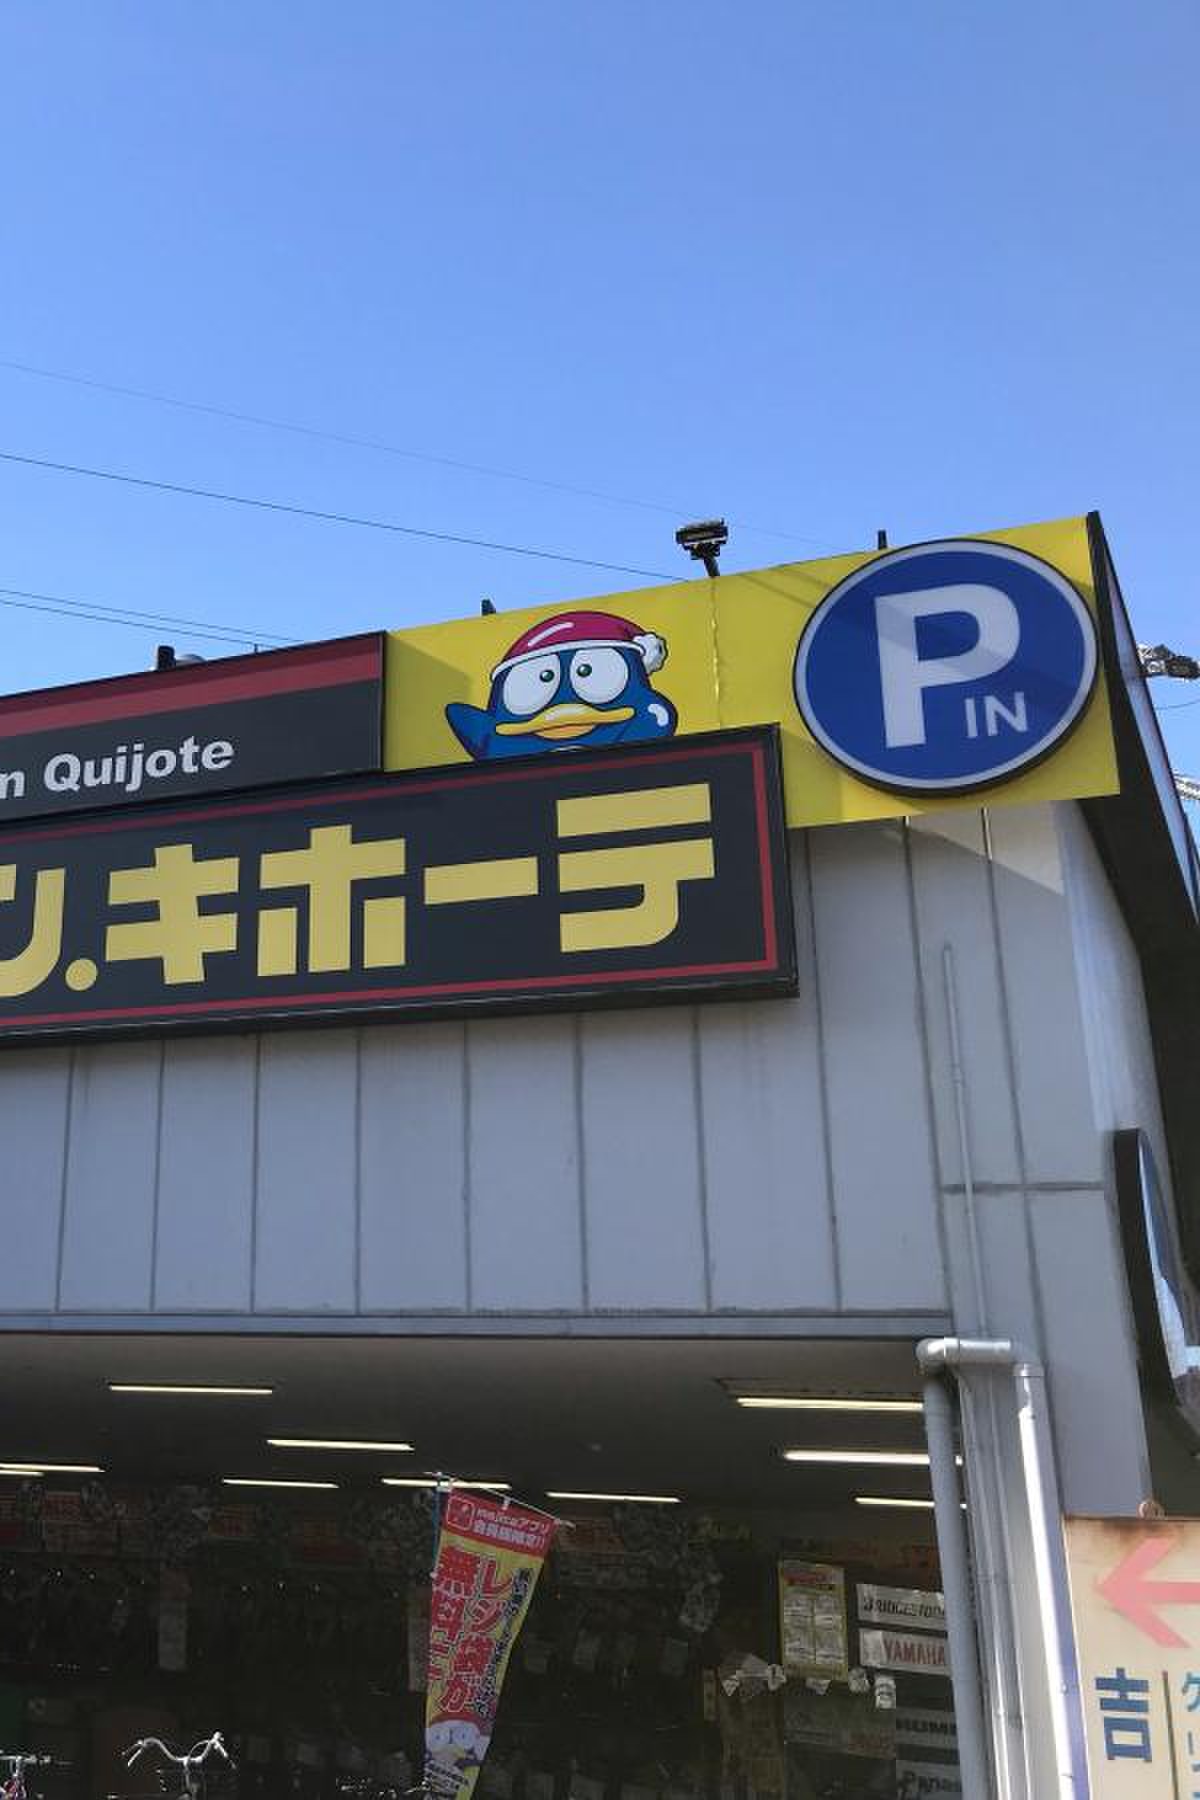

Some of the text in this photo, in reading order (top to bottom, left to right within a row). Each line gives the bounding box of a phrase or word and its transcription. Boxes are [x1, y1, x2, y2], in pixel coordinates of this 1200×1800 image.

[874, 583, 1021, 749] P
[964, 692, 1028, 739] IN
[43, 735, 234, 793] Quijote
